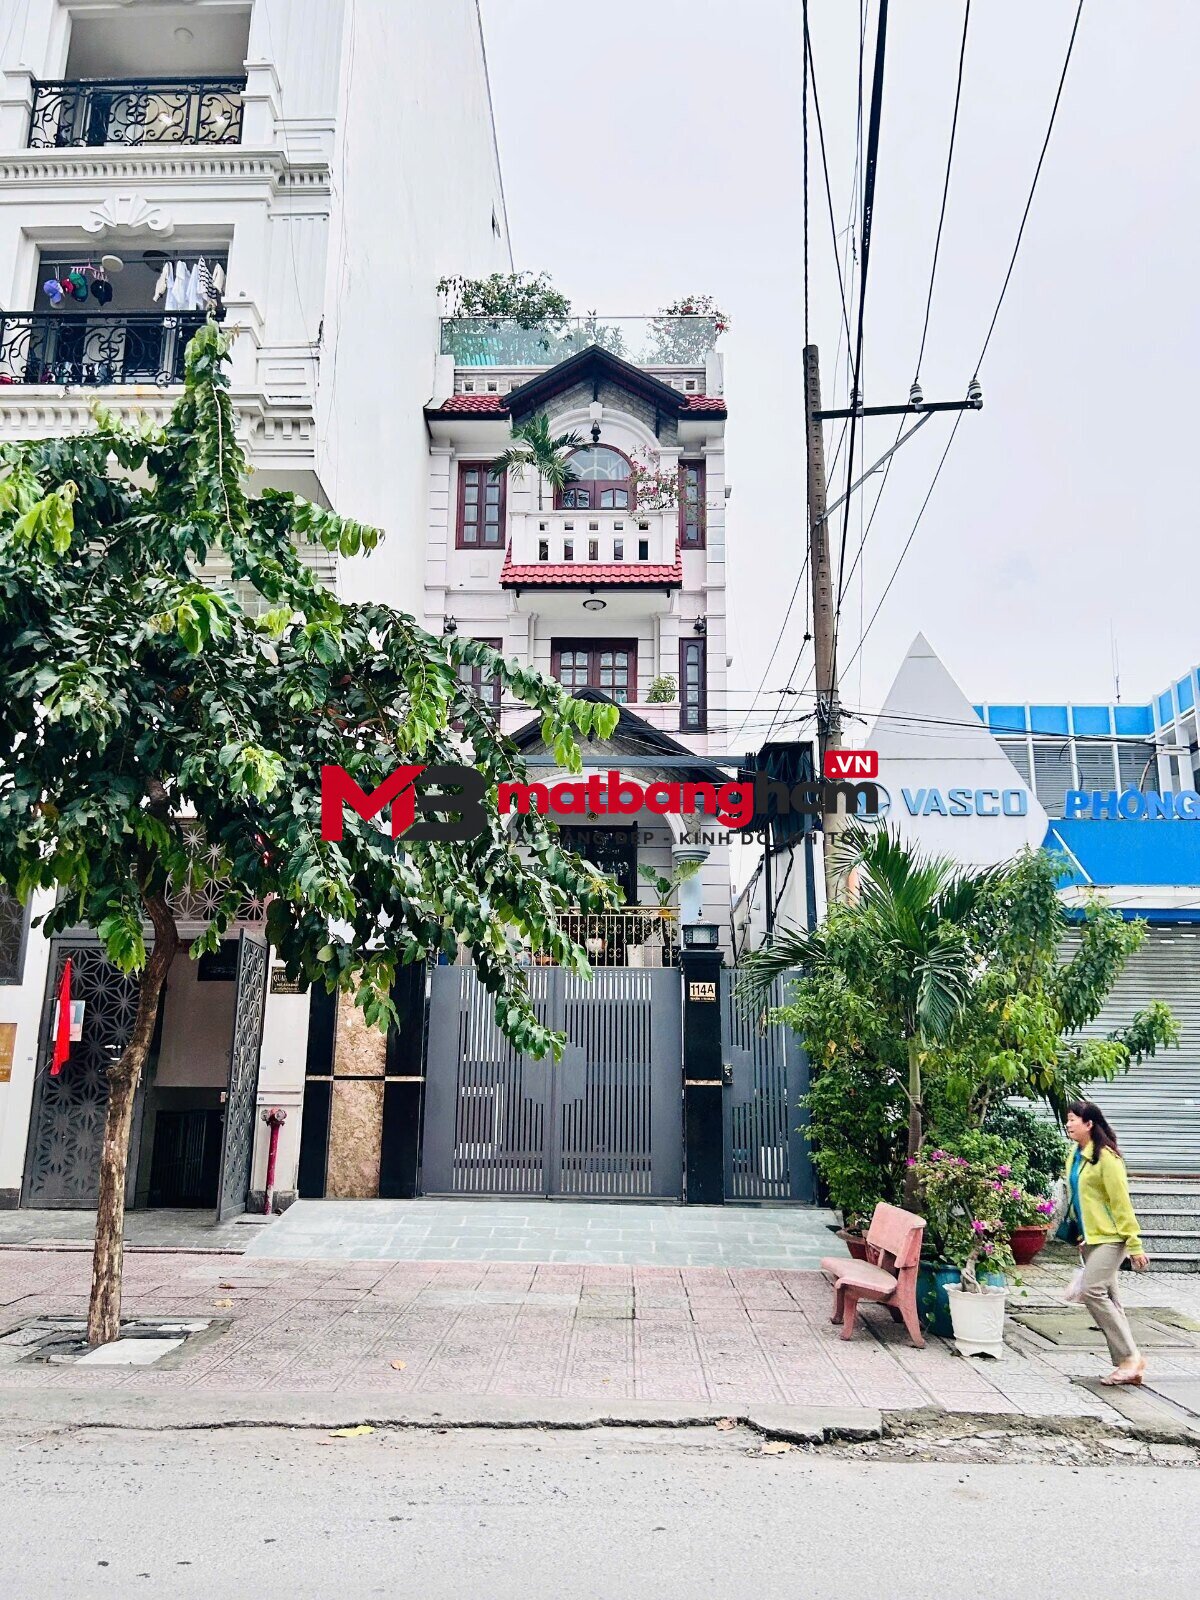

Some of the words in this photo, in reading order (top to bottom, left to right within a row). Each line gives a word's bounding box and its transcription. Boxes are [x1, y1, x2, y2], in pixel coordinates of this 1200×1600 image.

[901, 788, 1028, 817] VASCO
[1065, 781, 1200, 820] PHÒNG
[691, 984, 714, 996] 114A
